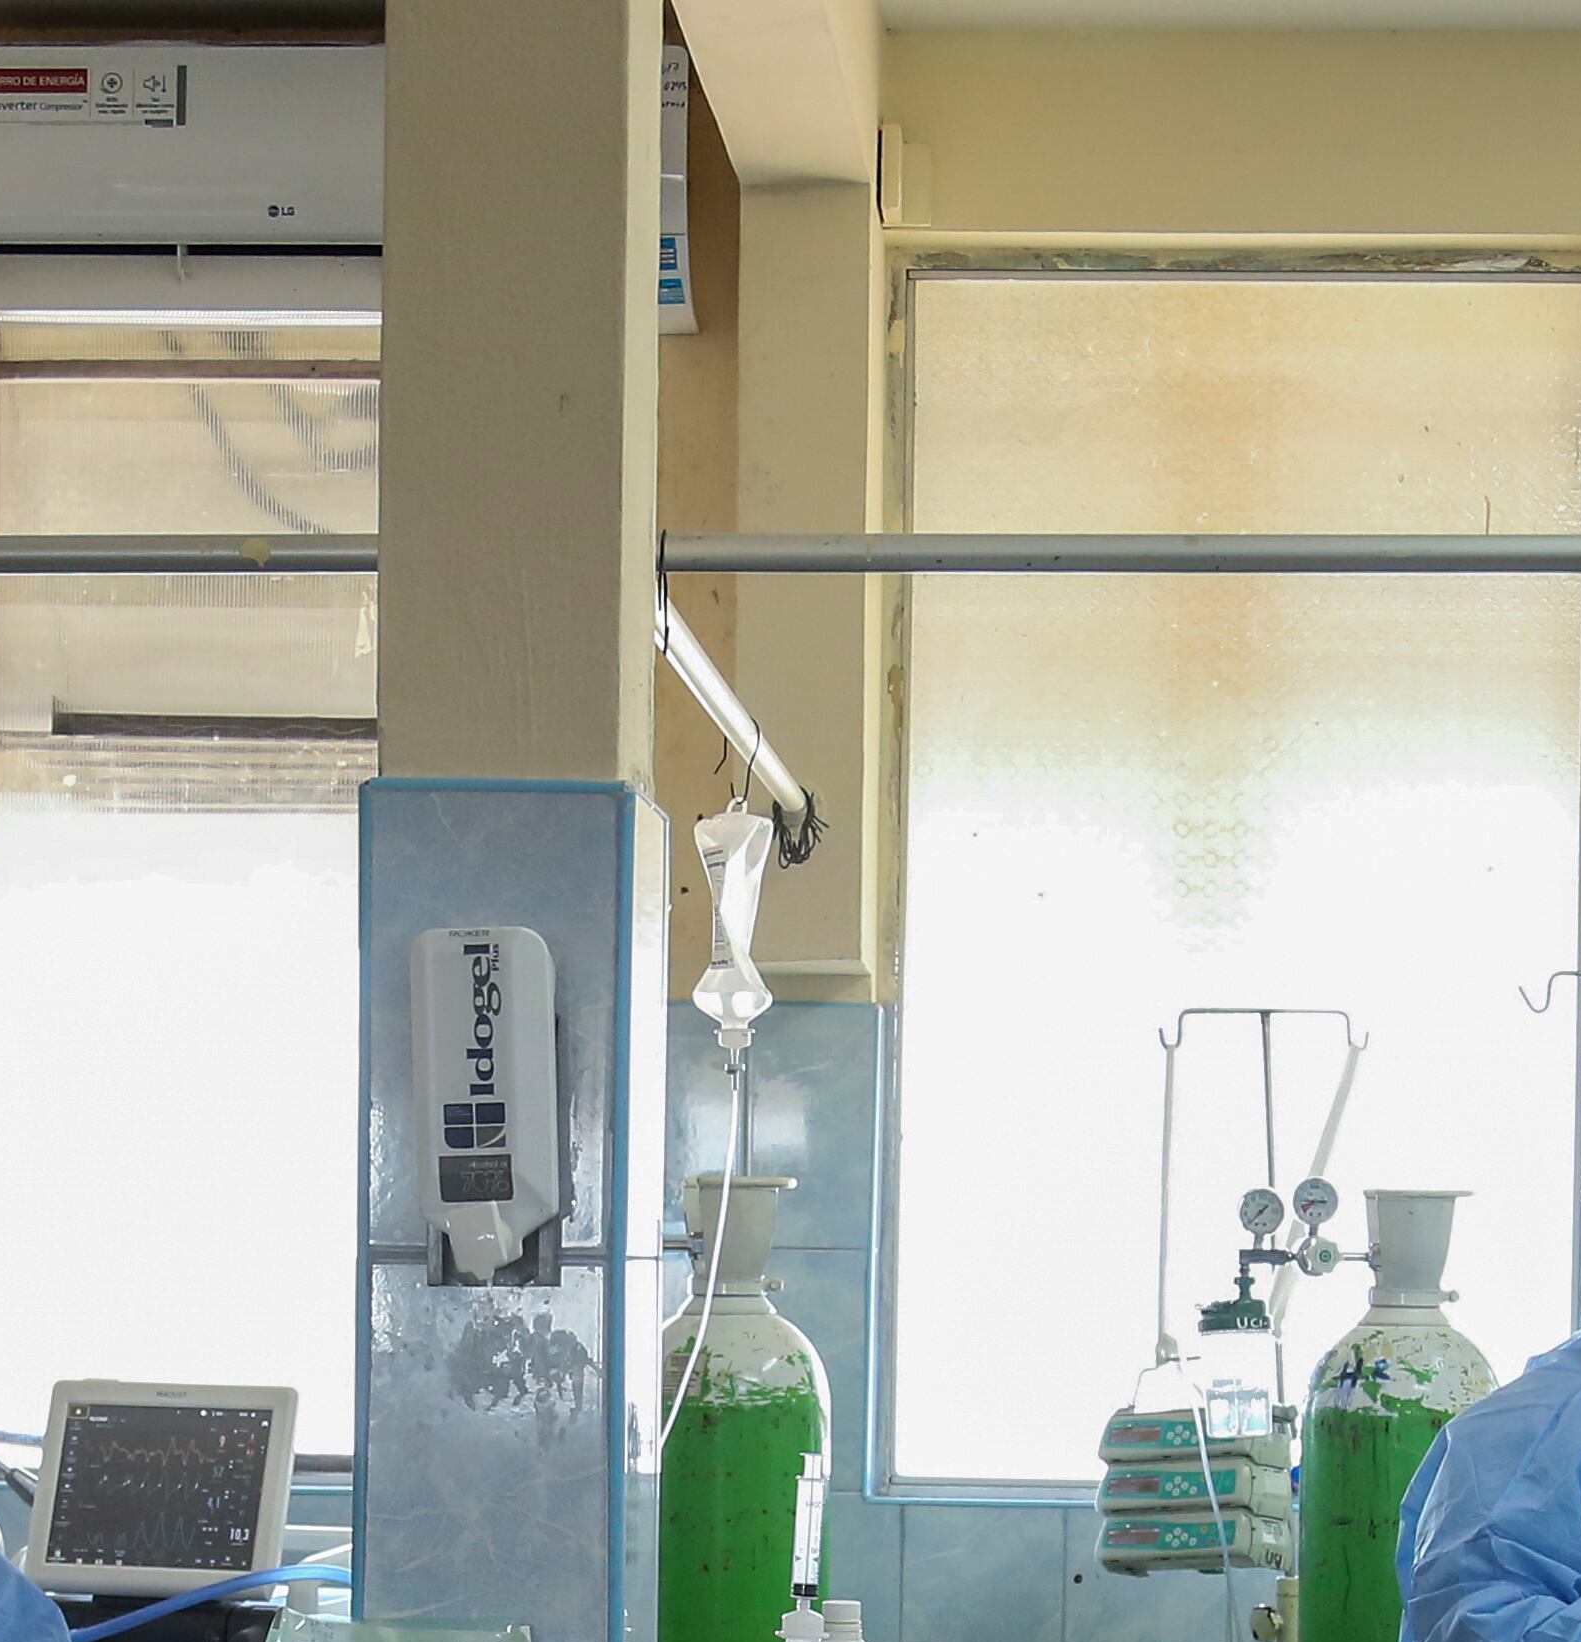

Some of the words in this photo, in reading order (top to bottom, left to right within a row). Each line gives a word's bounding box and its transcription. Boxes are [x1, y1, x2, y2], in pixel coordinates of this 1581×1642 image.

[23, 75, 37, 87] DE
[39, 72, 85, 87] ENERGÍA
[281, 206, 295, 217] LG
